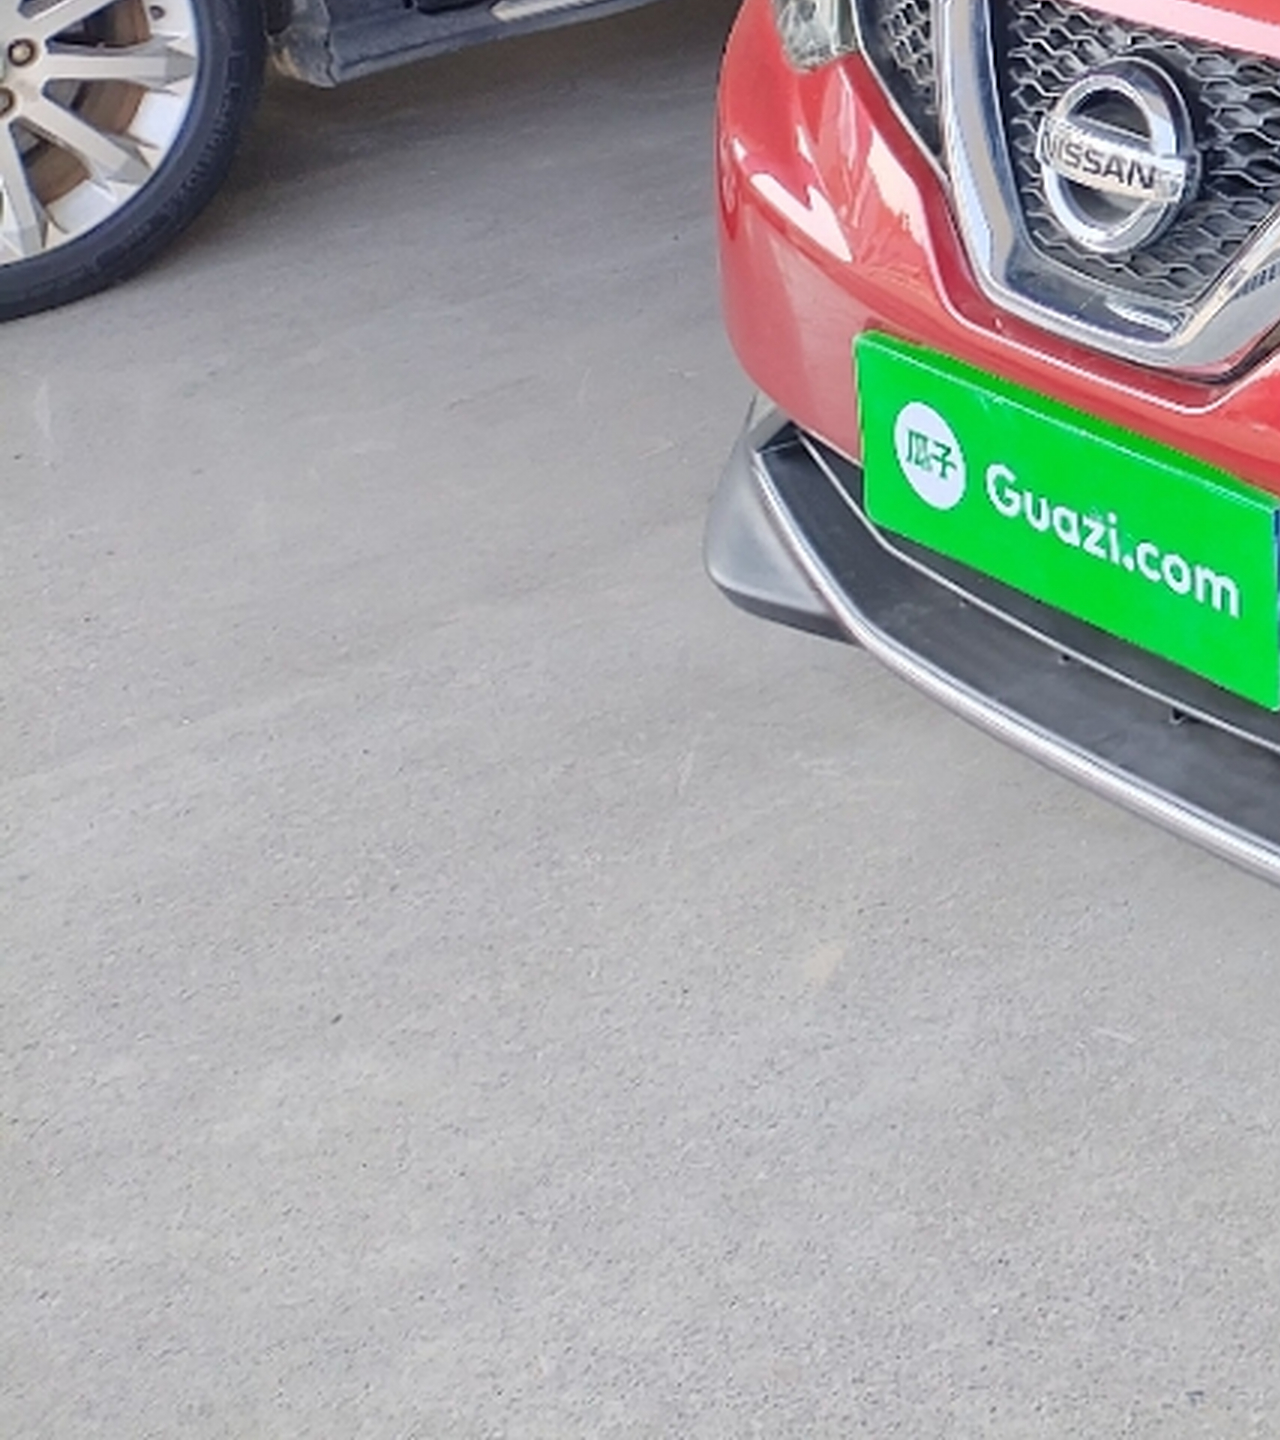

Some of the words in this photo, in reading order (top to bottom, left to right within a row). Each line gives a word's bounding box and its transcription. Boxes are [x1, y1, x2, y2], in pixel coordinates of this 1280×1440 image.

[1042, 133, 1157, 191] NISSAN
[905, 427, 958, 480] 瓜子
[985, 463, 1241, 620] Guazi.com
